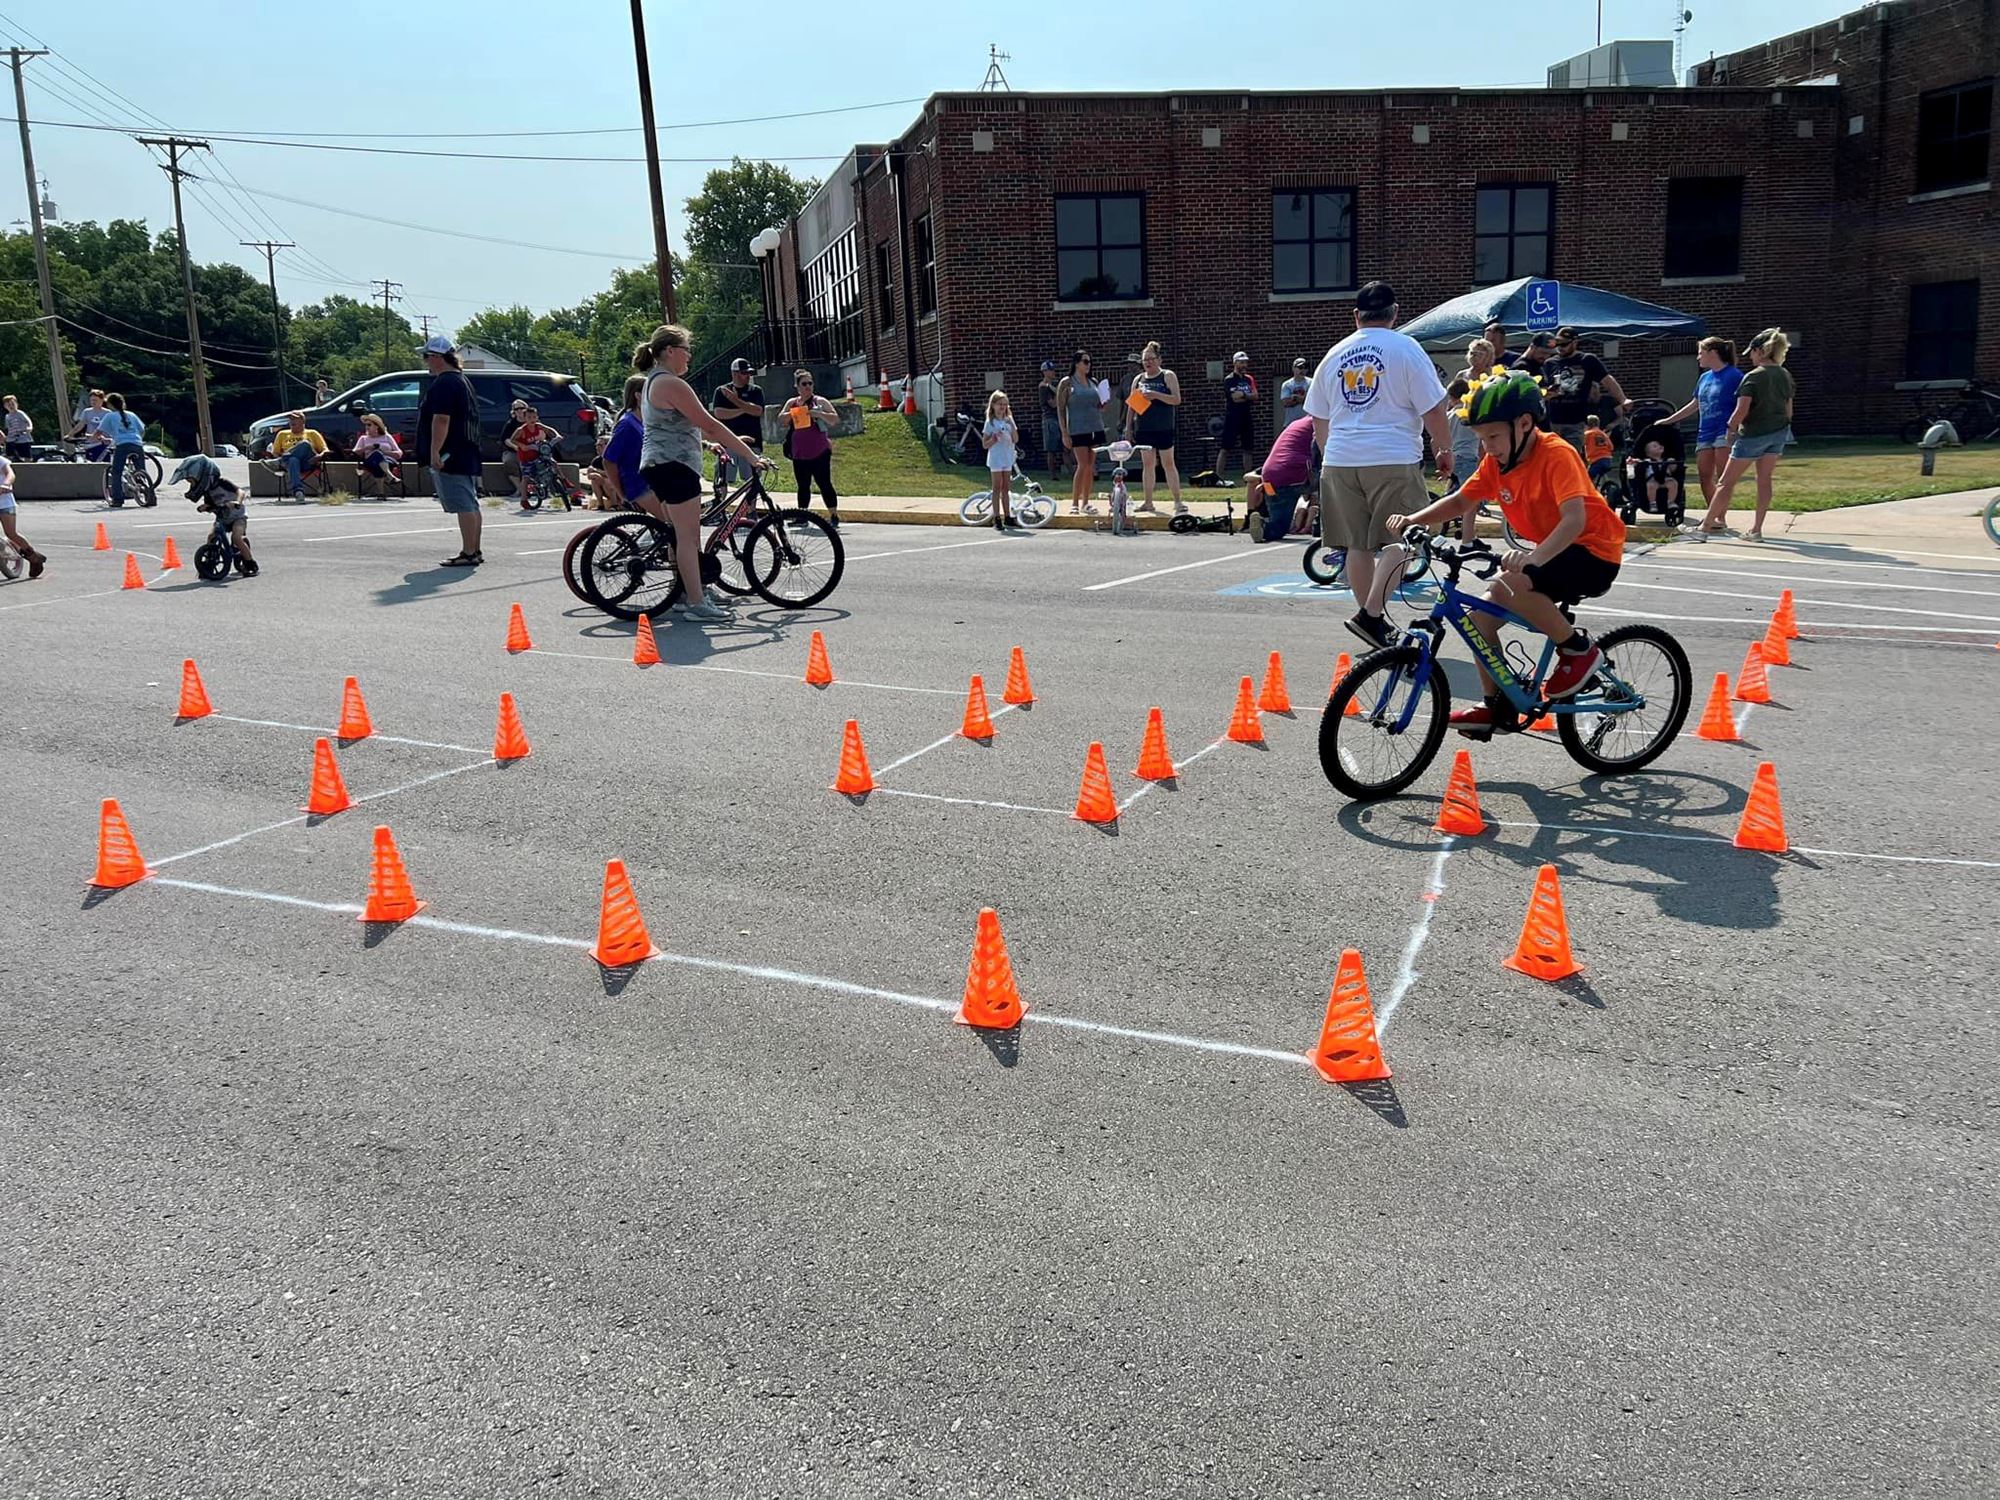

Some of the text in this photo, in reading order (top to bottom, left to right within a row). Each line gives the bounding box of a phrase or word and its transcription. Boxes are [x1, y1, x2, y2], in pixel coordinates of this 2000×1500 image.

[1528, 315, 1557, 325] PARKING
[1341, 345, 1383, 361] PLEASANT HILL
[1337, 353, 1385, 377] OPTIMISTS
[1459, 614, 1514, 685] NISHIKI
